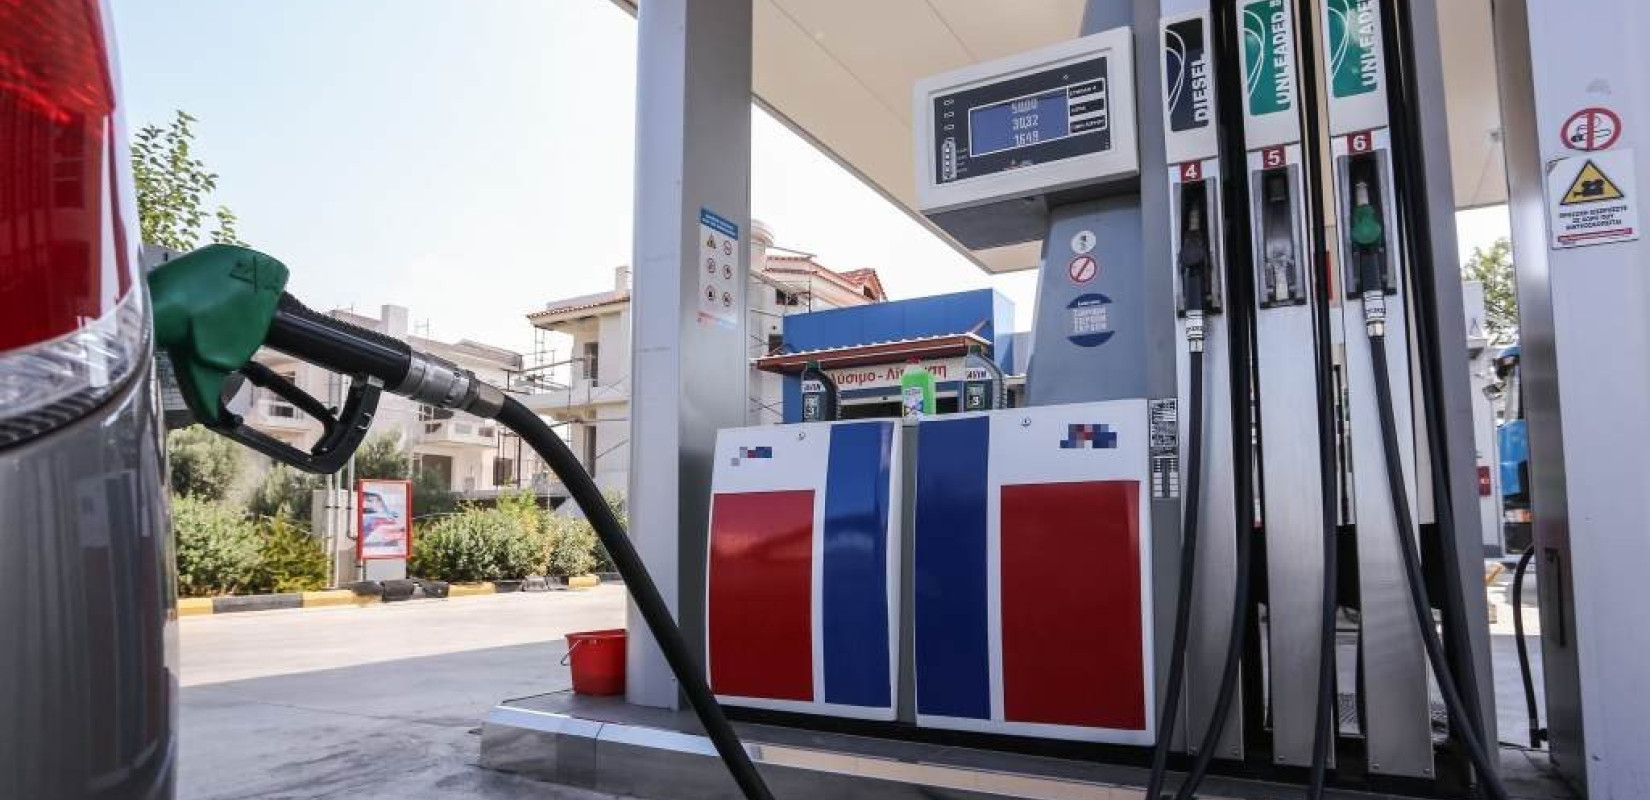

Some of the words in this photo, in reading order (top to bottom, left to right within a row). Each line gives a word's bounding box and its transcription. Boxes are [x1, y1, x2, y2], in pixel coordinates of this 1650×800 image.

[1270, 12, 1290, 105] UNLEADED
[1191, 54, 1209, 122] DIESEL
[1353, 135, 1366, 151] 6
[1268, 151, 1280, 166] 5
[1185, 165, 1198, 179] 4
